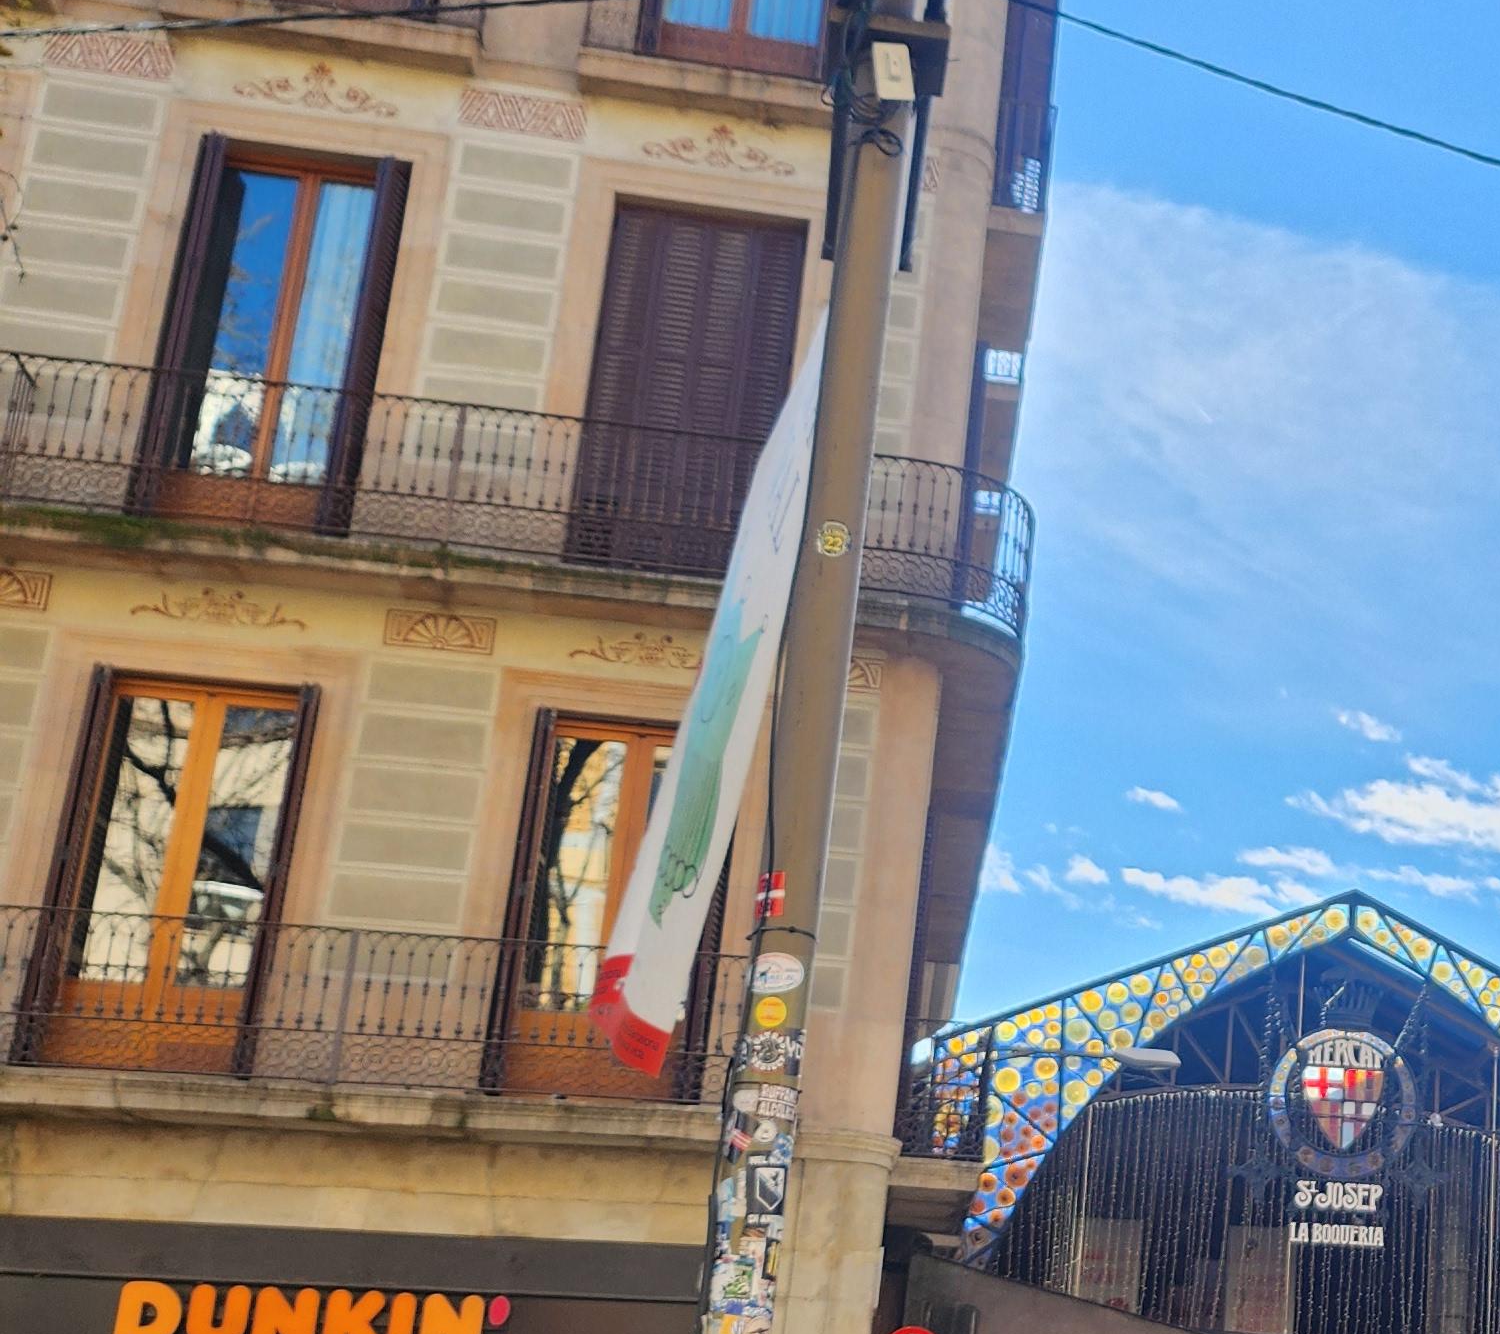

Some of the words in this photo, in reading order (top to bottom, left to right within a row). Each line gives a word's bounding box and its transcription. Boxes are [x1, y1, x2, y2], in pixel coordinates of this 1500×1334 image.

[1307, 1038, 1384, 1069] MERCAT
[1289, 1222, 1309, 1243] LA
[1311, 1223, 1384, 1247] BOQUERIA
